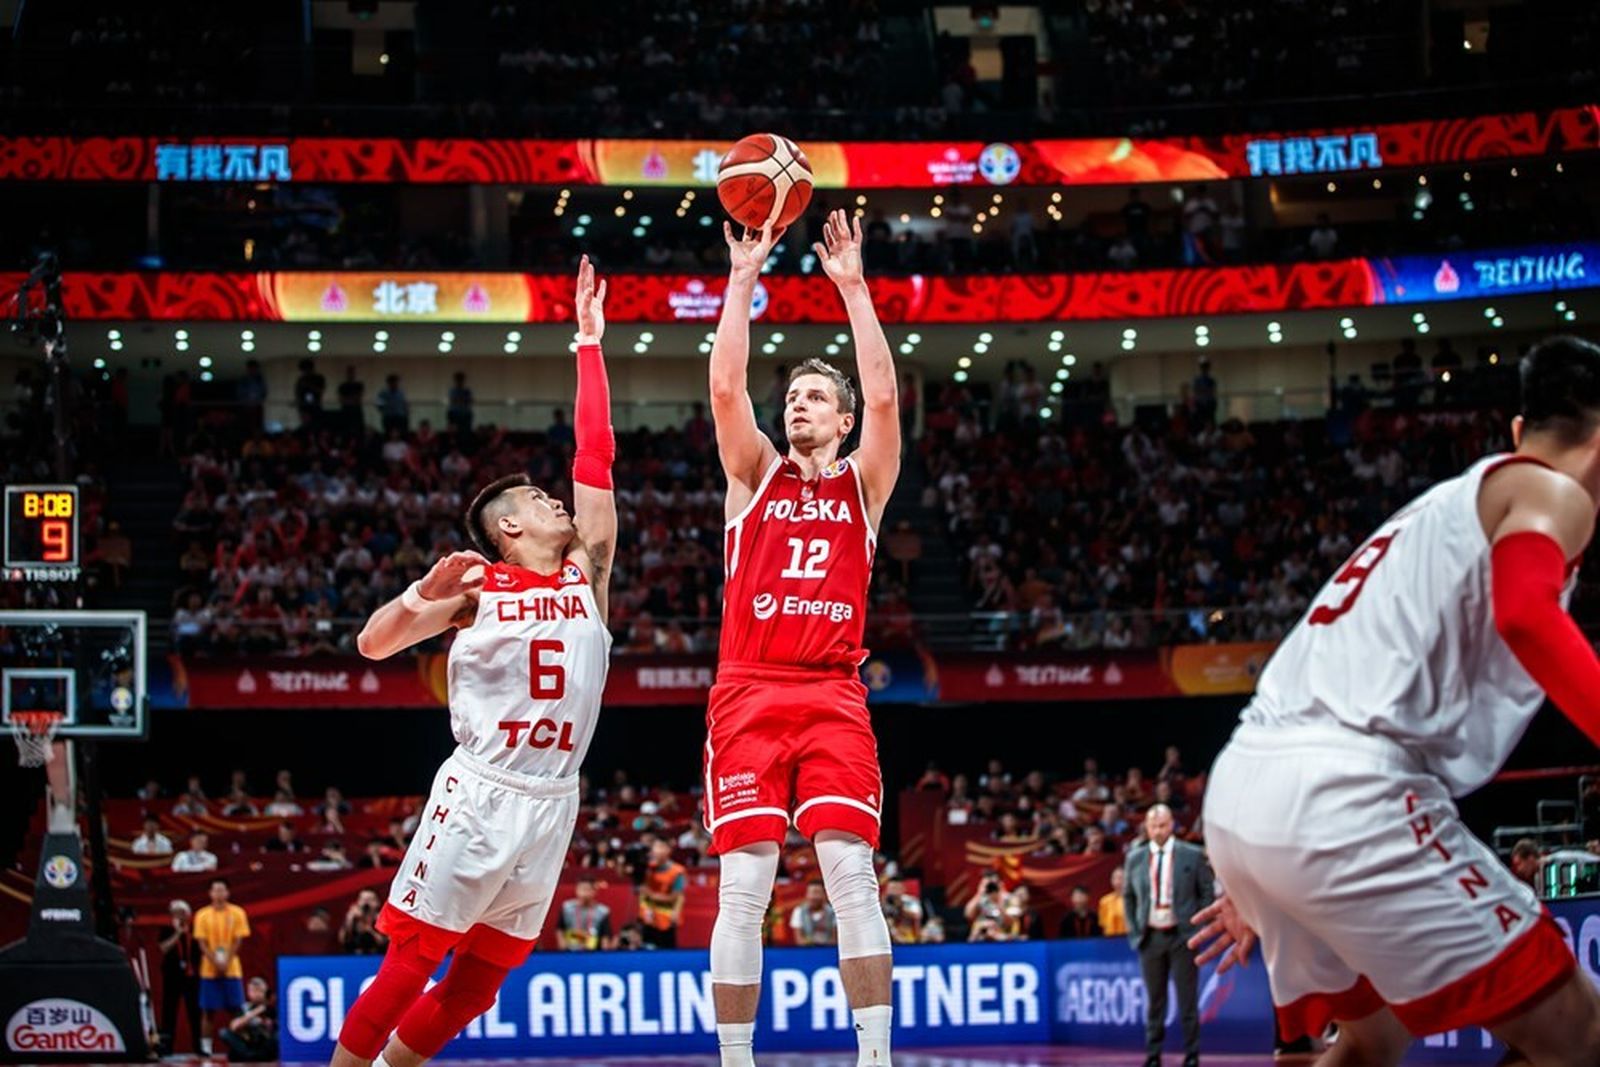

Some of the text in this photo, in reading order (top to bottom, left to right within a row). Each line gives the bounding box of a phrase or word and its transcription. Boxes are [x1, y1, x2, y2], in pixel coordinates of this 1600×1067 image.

[155, 144, 291, 181] 有我不凡
[1246, 132, 1382, 176] 有我不凡
[373, 280, 438, 314] 北京
[24, 494, 72, 517] 8:08
[763, 499, 852, 524] POLSKA
[43, 521, 68, 560] 9
[781, 537, 831, 579] 12
[1308, 529, 1400, 626] 9
[497, 595, 589, 622] CHINA
[782, 596, 852, 623] Energa
[529, 639, 565, 700] 6
[498, 718, 576, 752] TCL
[402, 776, 458, 907] CHINA
[528, 969, 716, 1034] AIRLIN
[771, 961, 1039, 1032] PATNER
